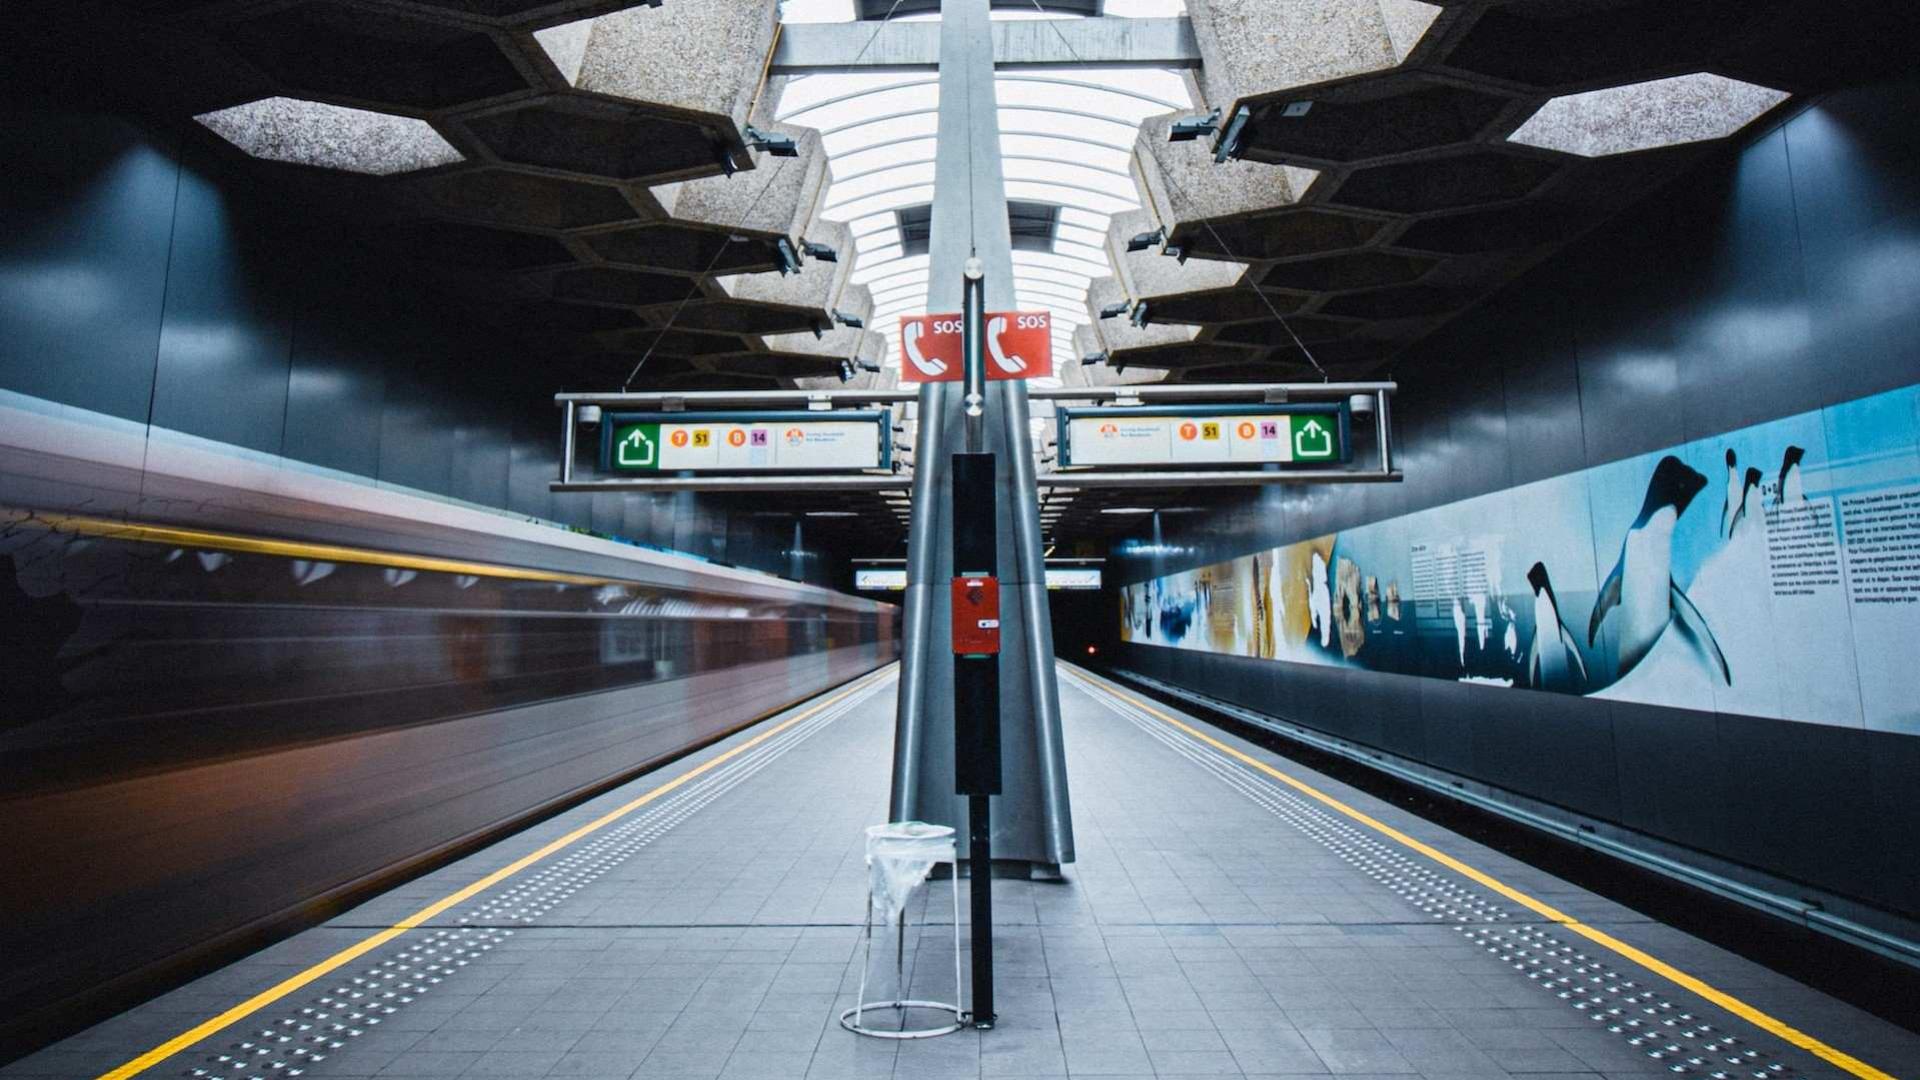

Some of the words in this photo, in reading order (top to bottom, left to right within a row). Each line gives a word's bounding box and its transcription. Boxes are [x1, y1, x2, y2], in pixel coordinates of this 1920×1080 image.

[933, 320, 963, 334] SOS
[1017, 315, 1046, 329] SOS
[1204, 426, 1216, 436] 51
[1263, 426, 1275, 435] 14
[695, 433, 707, 443] 51
[752, 433, 765, 443] 14
